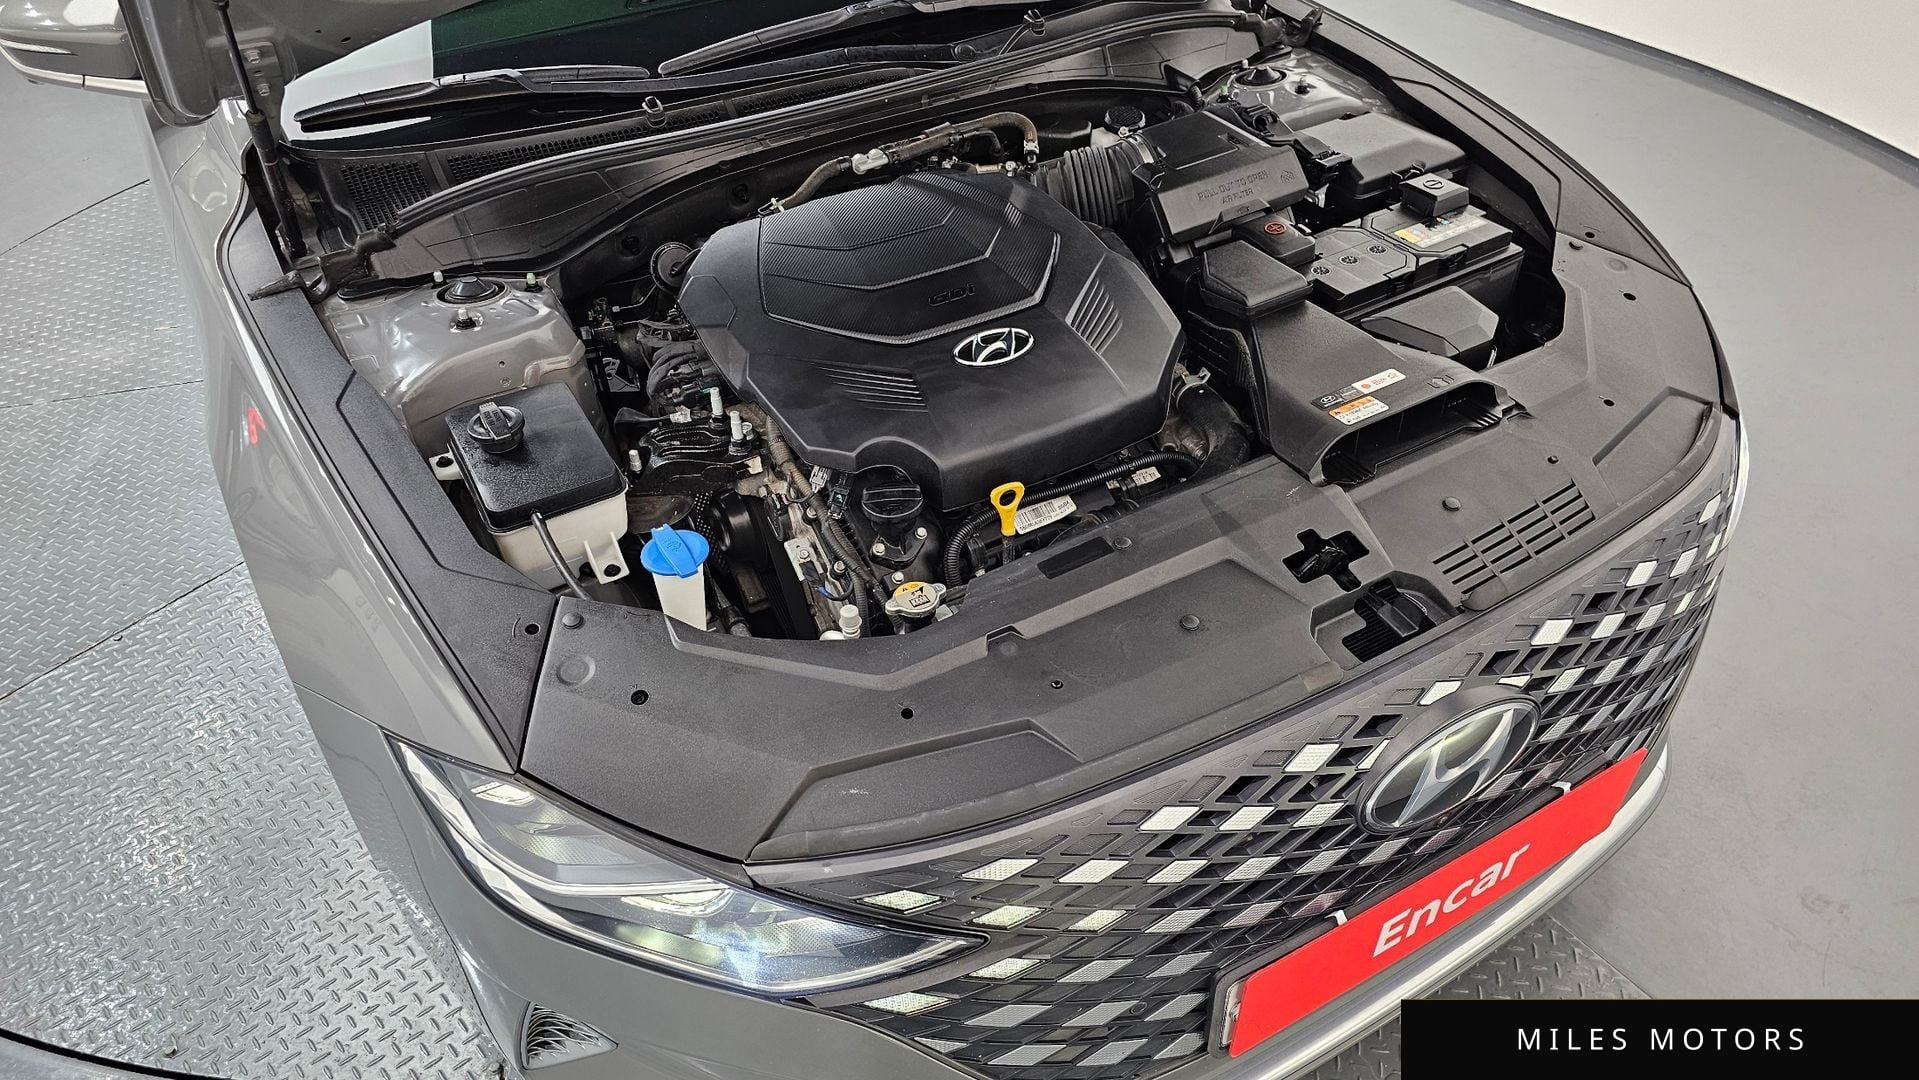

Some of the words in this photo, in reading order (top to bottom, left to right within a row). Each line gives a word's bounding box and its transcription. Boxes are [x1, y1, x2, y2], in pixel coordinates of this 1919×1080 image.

[1197, 189, 1219, 201] PULL
[1219, 182, 1234, 193] OUT
[1234, 177, 1247, 187] TO
[1248, 170, 1269, 184] OPEN
[1222, 194, 1233, 204] AIR
[1233, 188, 1254, 199] FILTER
[1373, 843, 1531, 958] Encar
